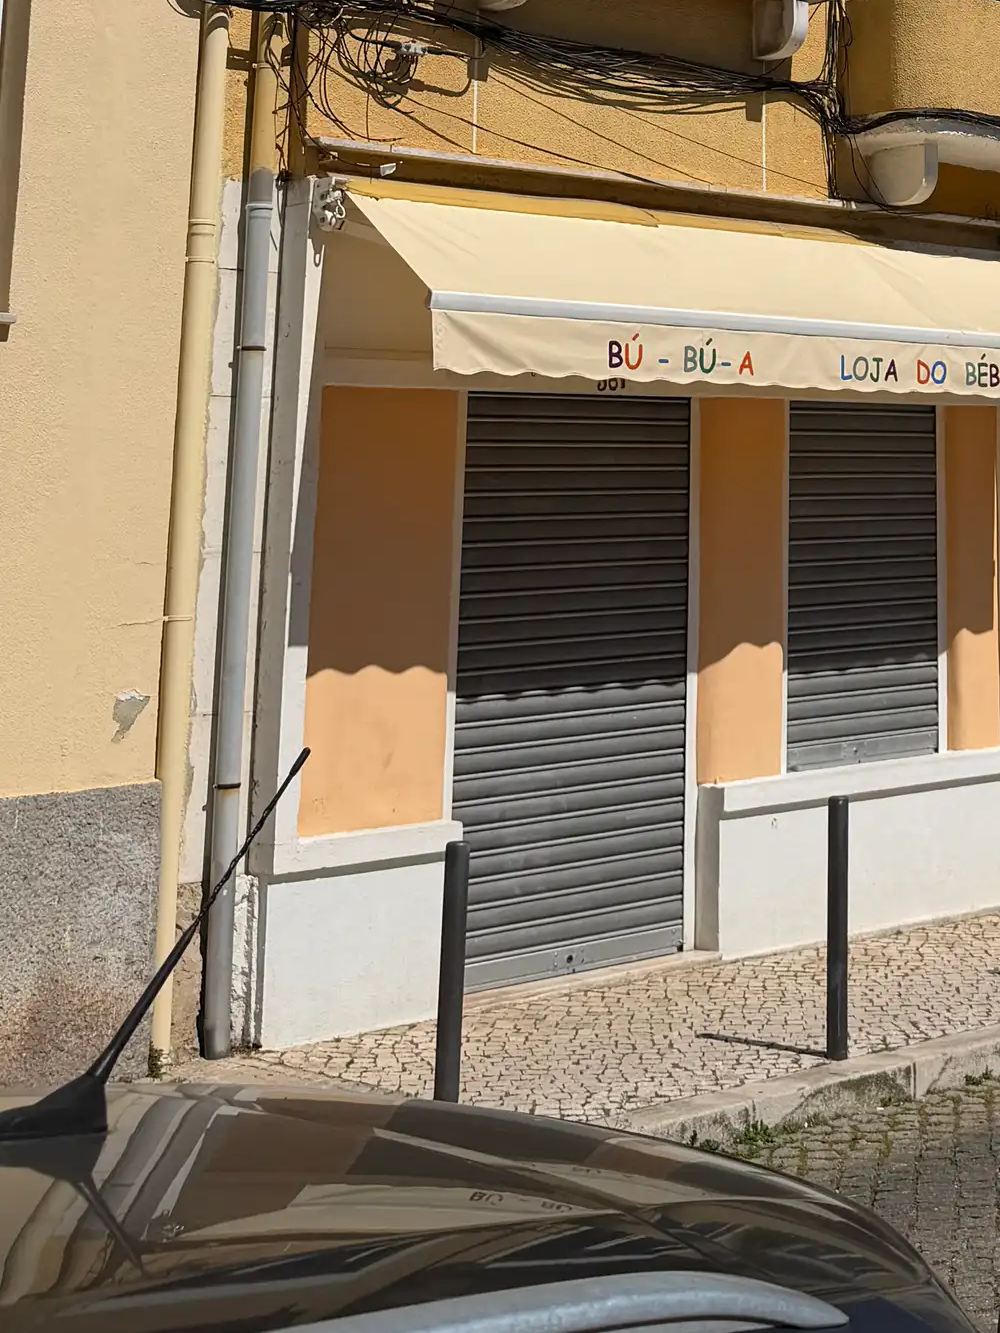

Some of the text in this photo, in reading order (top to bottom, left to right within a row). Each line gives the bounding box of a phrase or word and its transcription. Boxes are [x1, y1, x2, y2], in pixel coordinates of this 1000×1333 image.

[608, 333, 643, 370] BÚ
[840, 354, 898, 383] LOJA
[917, 359, 947, 385] DO
